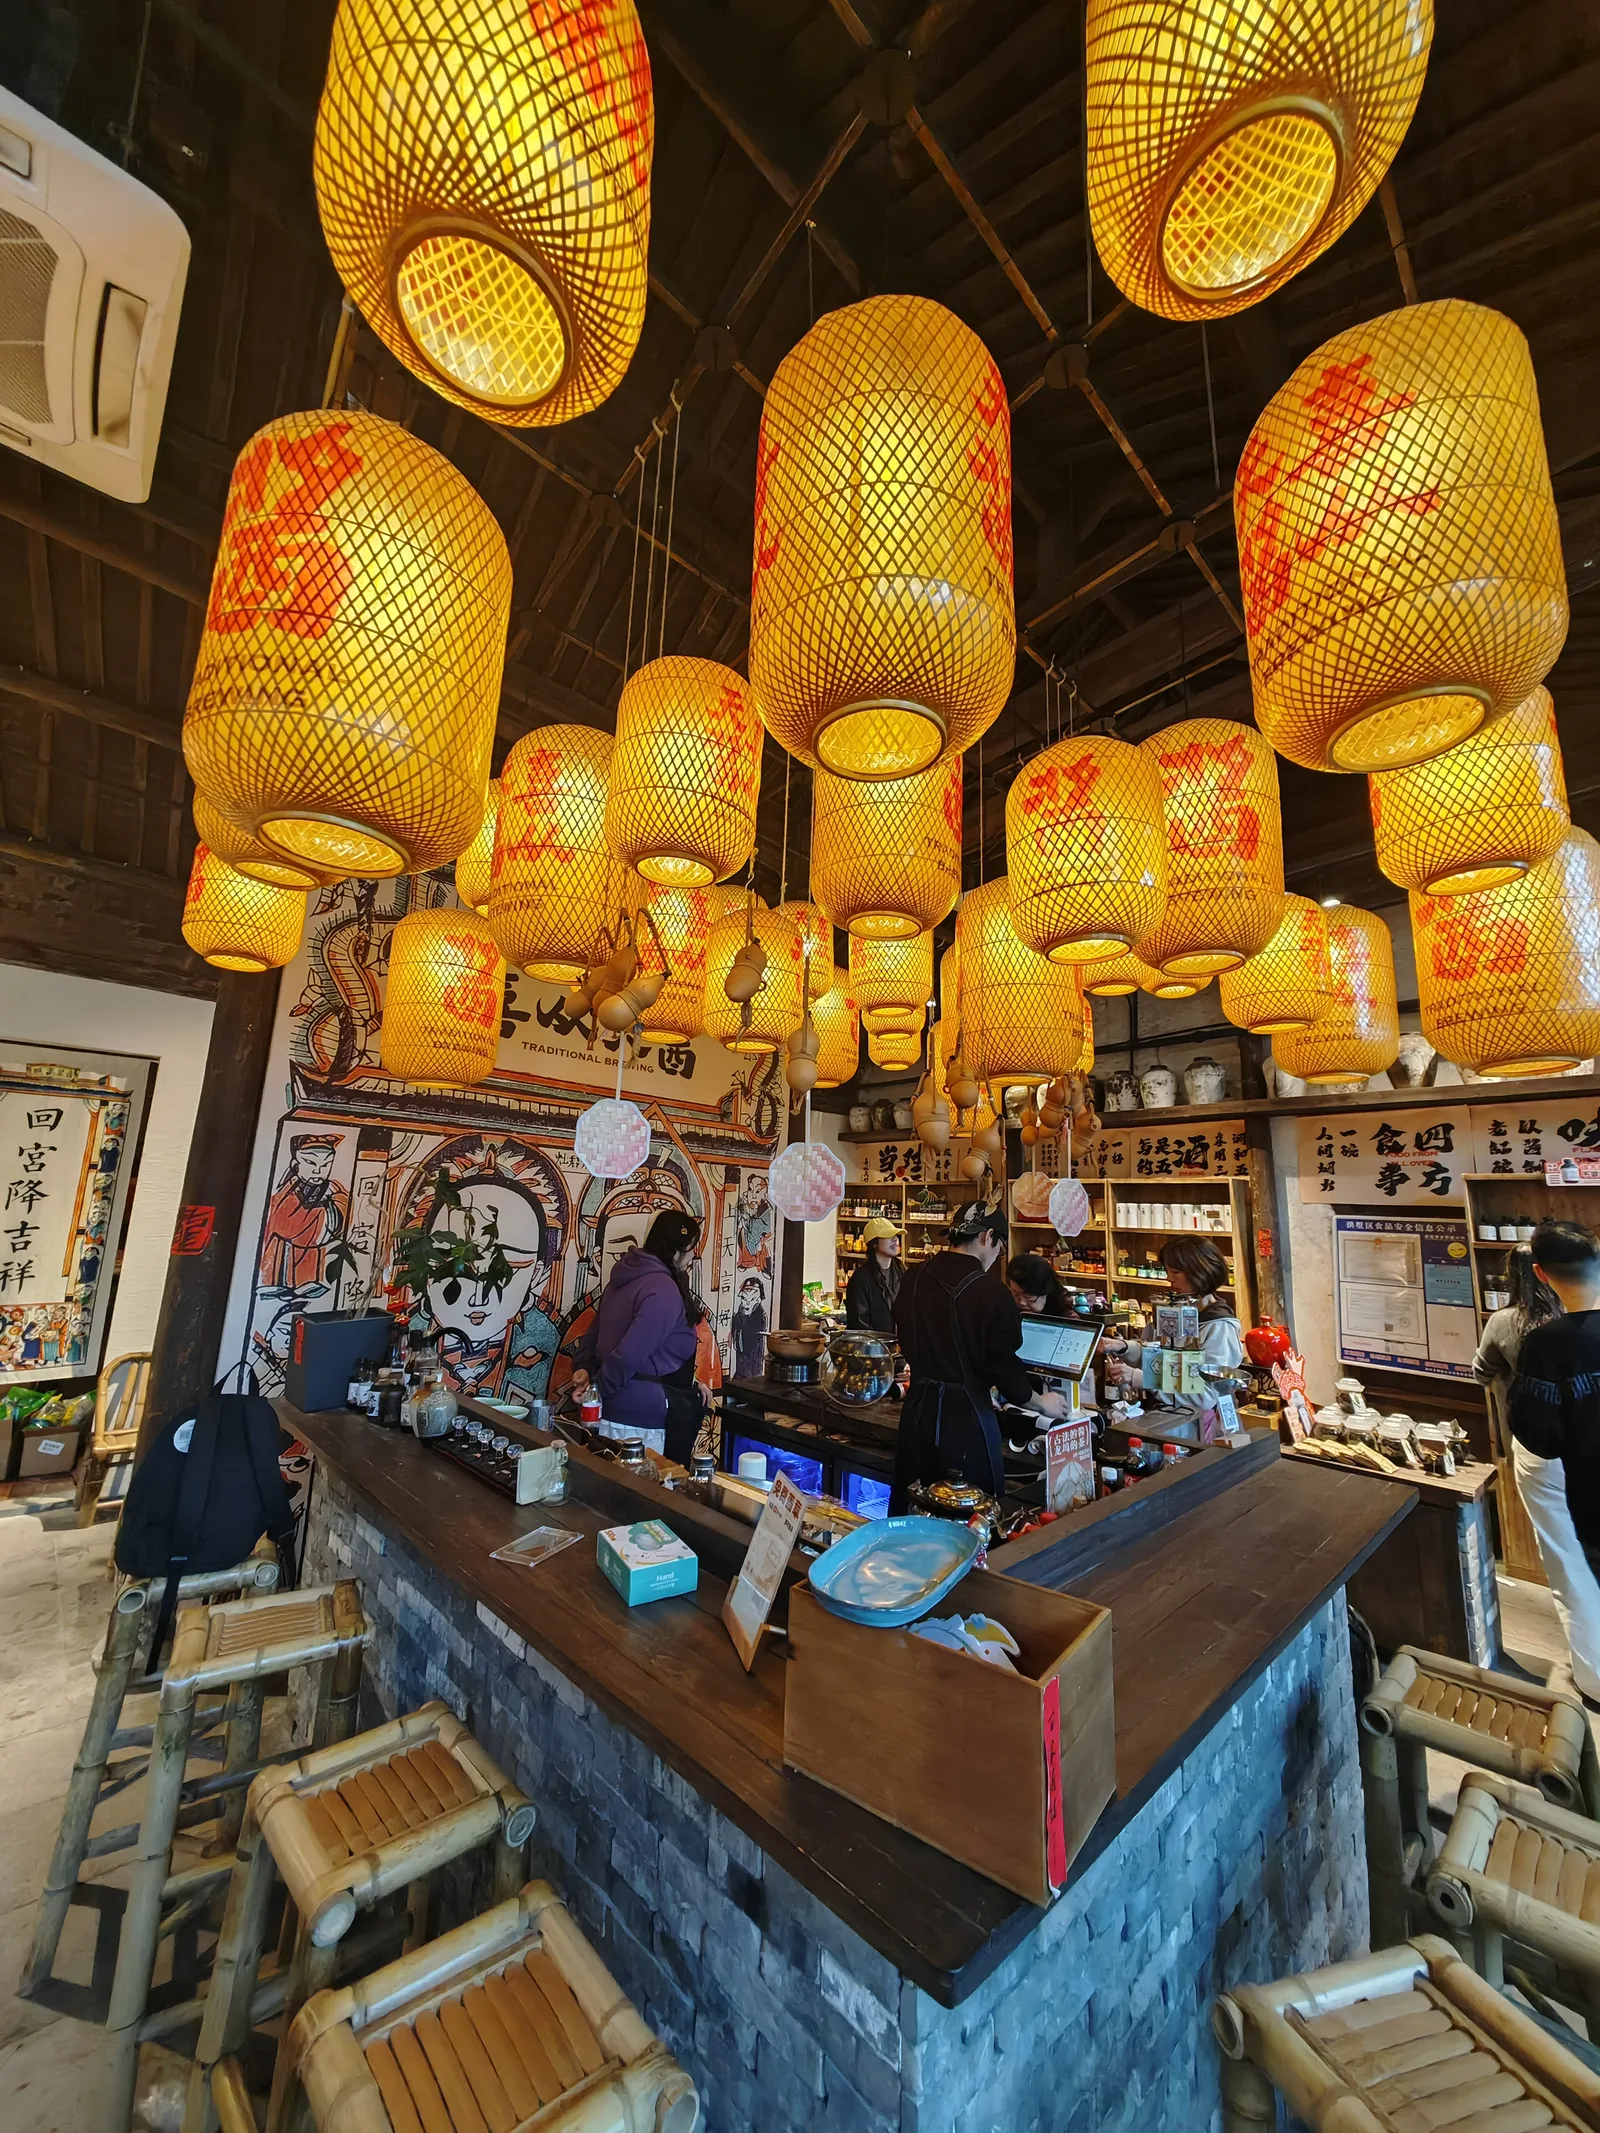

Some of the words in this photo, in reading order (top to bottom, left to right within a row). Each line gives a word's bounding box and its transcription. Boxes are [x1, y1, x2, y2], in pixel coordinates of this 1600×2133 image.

[521, 1041, 601, 1065] TRADITIONAL
[1172, 1134, 1211, 1171] 酒
[656, 1571, 675, 1583] Hand
